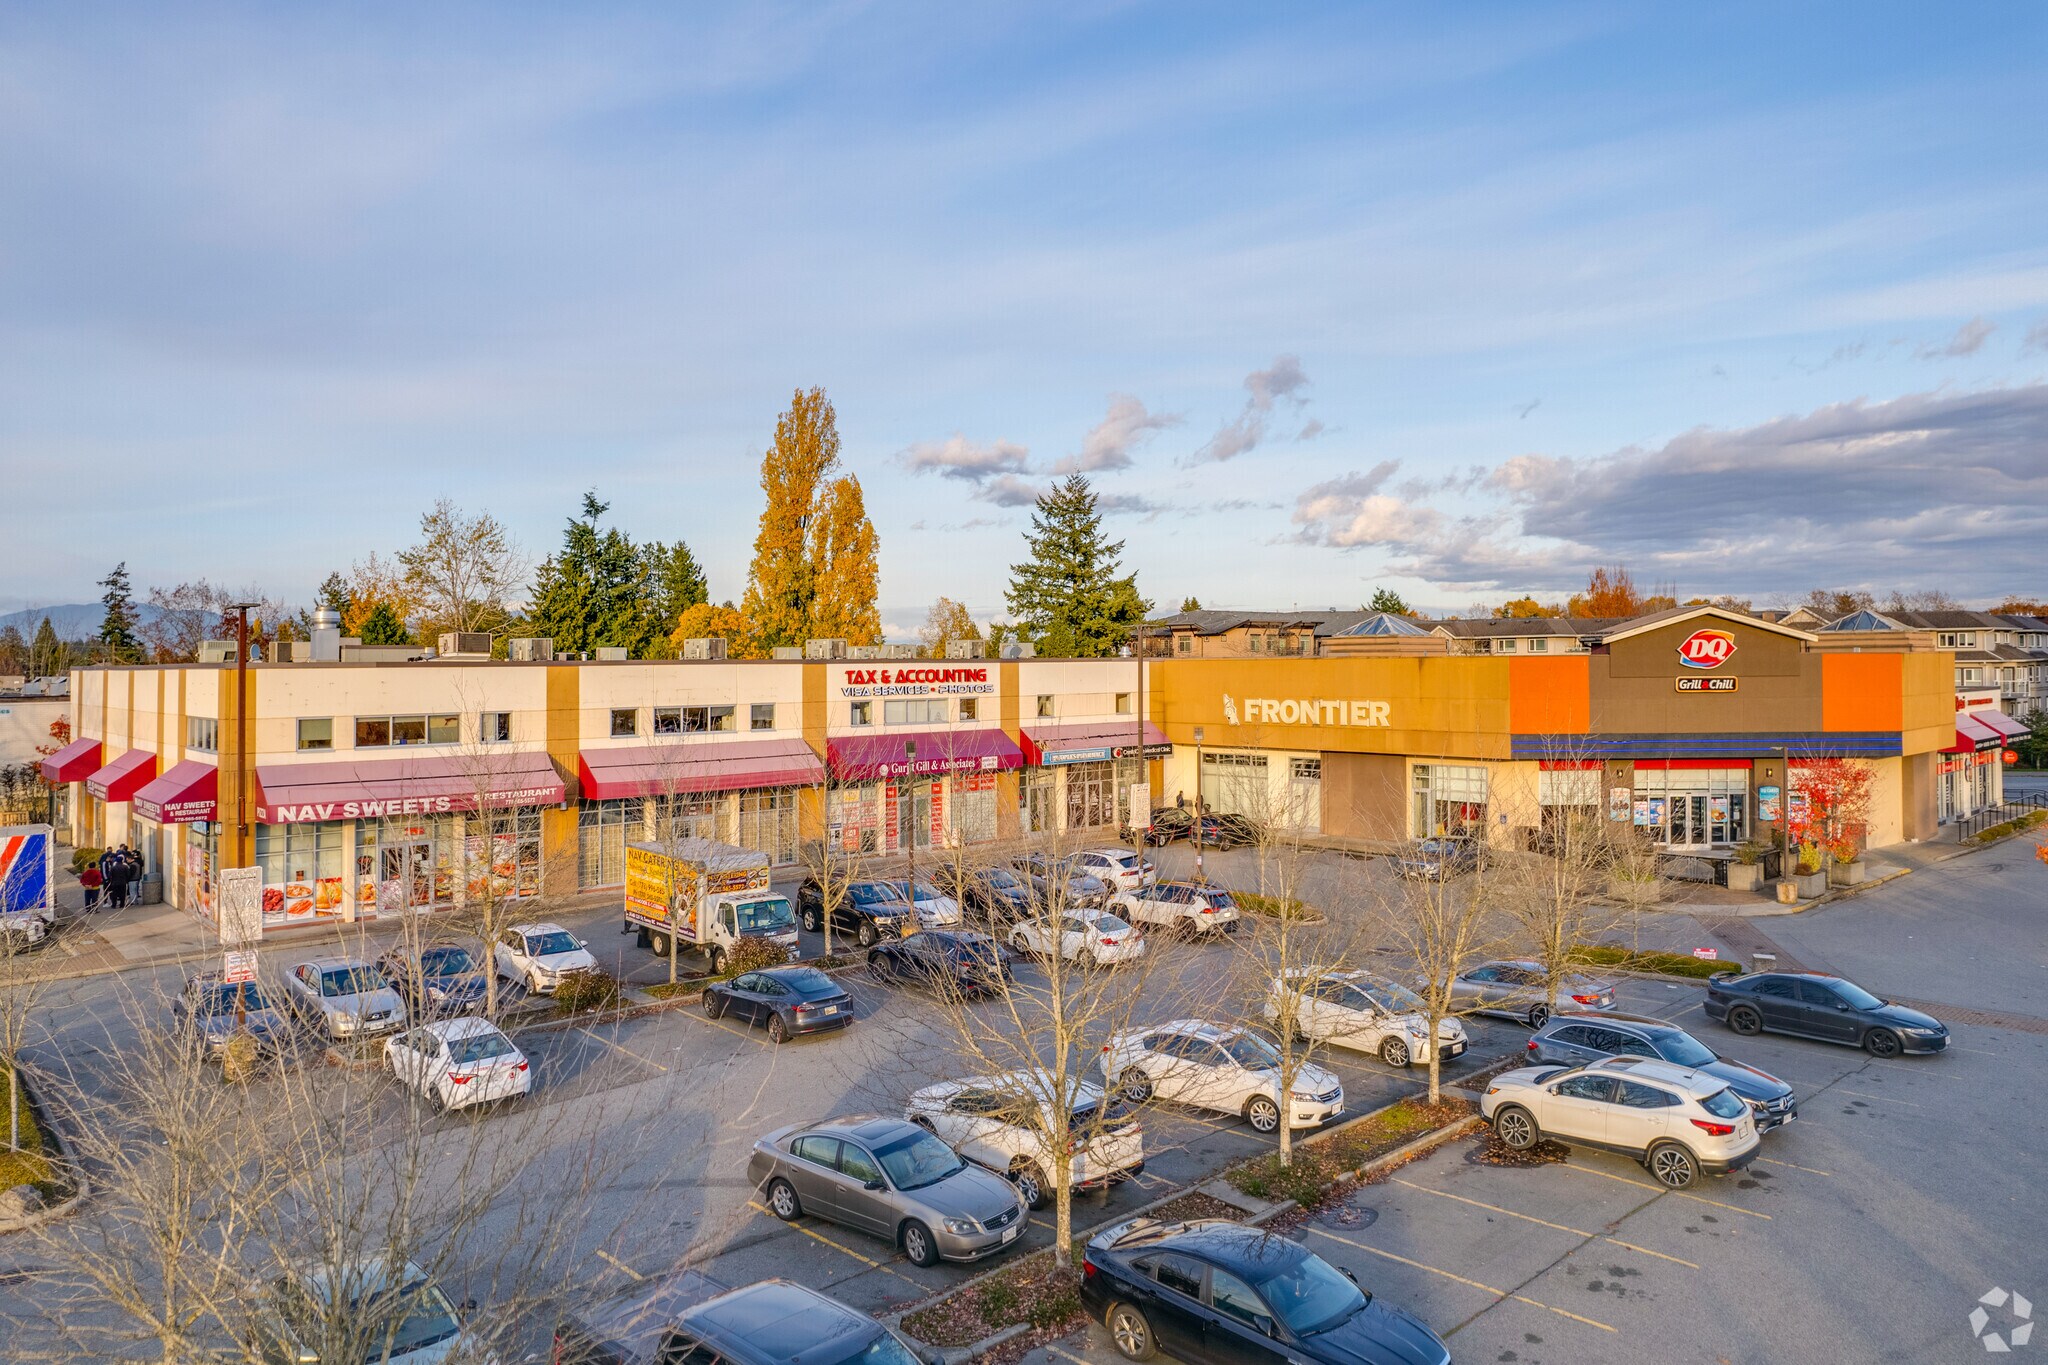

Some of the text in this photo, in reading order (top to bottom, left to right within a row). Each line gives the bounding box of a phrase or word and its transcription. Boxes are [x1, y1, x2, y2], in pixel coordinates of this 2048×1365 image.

[1689, 638, 1728, 660] DQ
[845, 669, 987, 684] TAX & ACCOUNTING
[841, 684, 994, 697] VISA SERVICES PHOTOS
[1679, 679, 1702, 690] Grill
[1709, 679, 1734, 690] Chill
[1244, 698, 1391, 727] FRONTIER
[891, 763, 915, 775] Gurjt
[916, 761, 930, 771] Gill
[931, 760, 938, 770] &
[484, 788, 557, 800] RESTAURANT
[165, 800, 216, 811] NAV SWEETS
[175, 808, 211, 816] RESTAURANT
[277, 804, 335, 823] NAV
[343, 796, 452, 818] SWEETS
[628, 850, 642, 861] NAV
